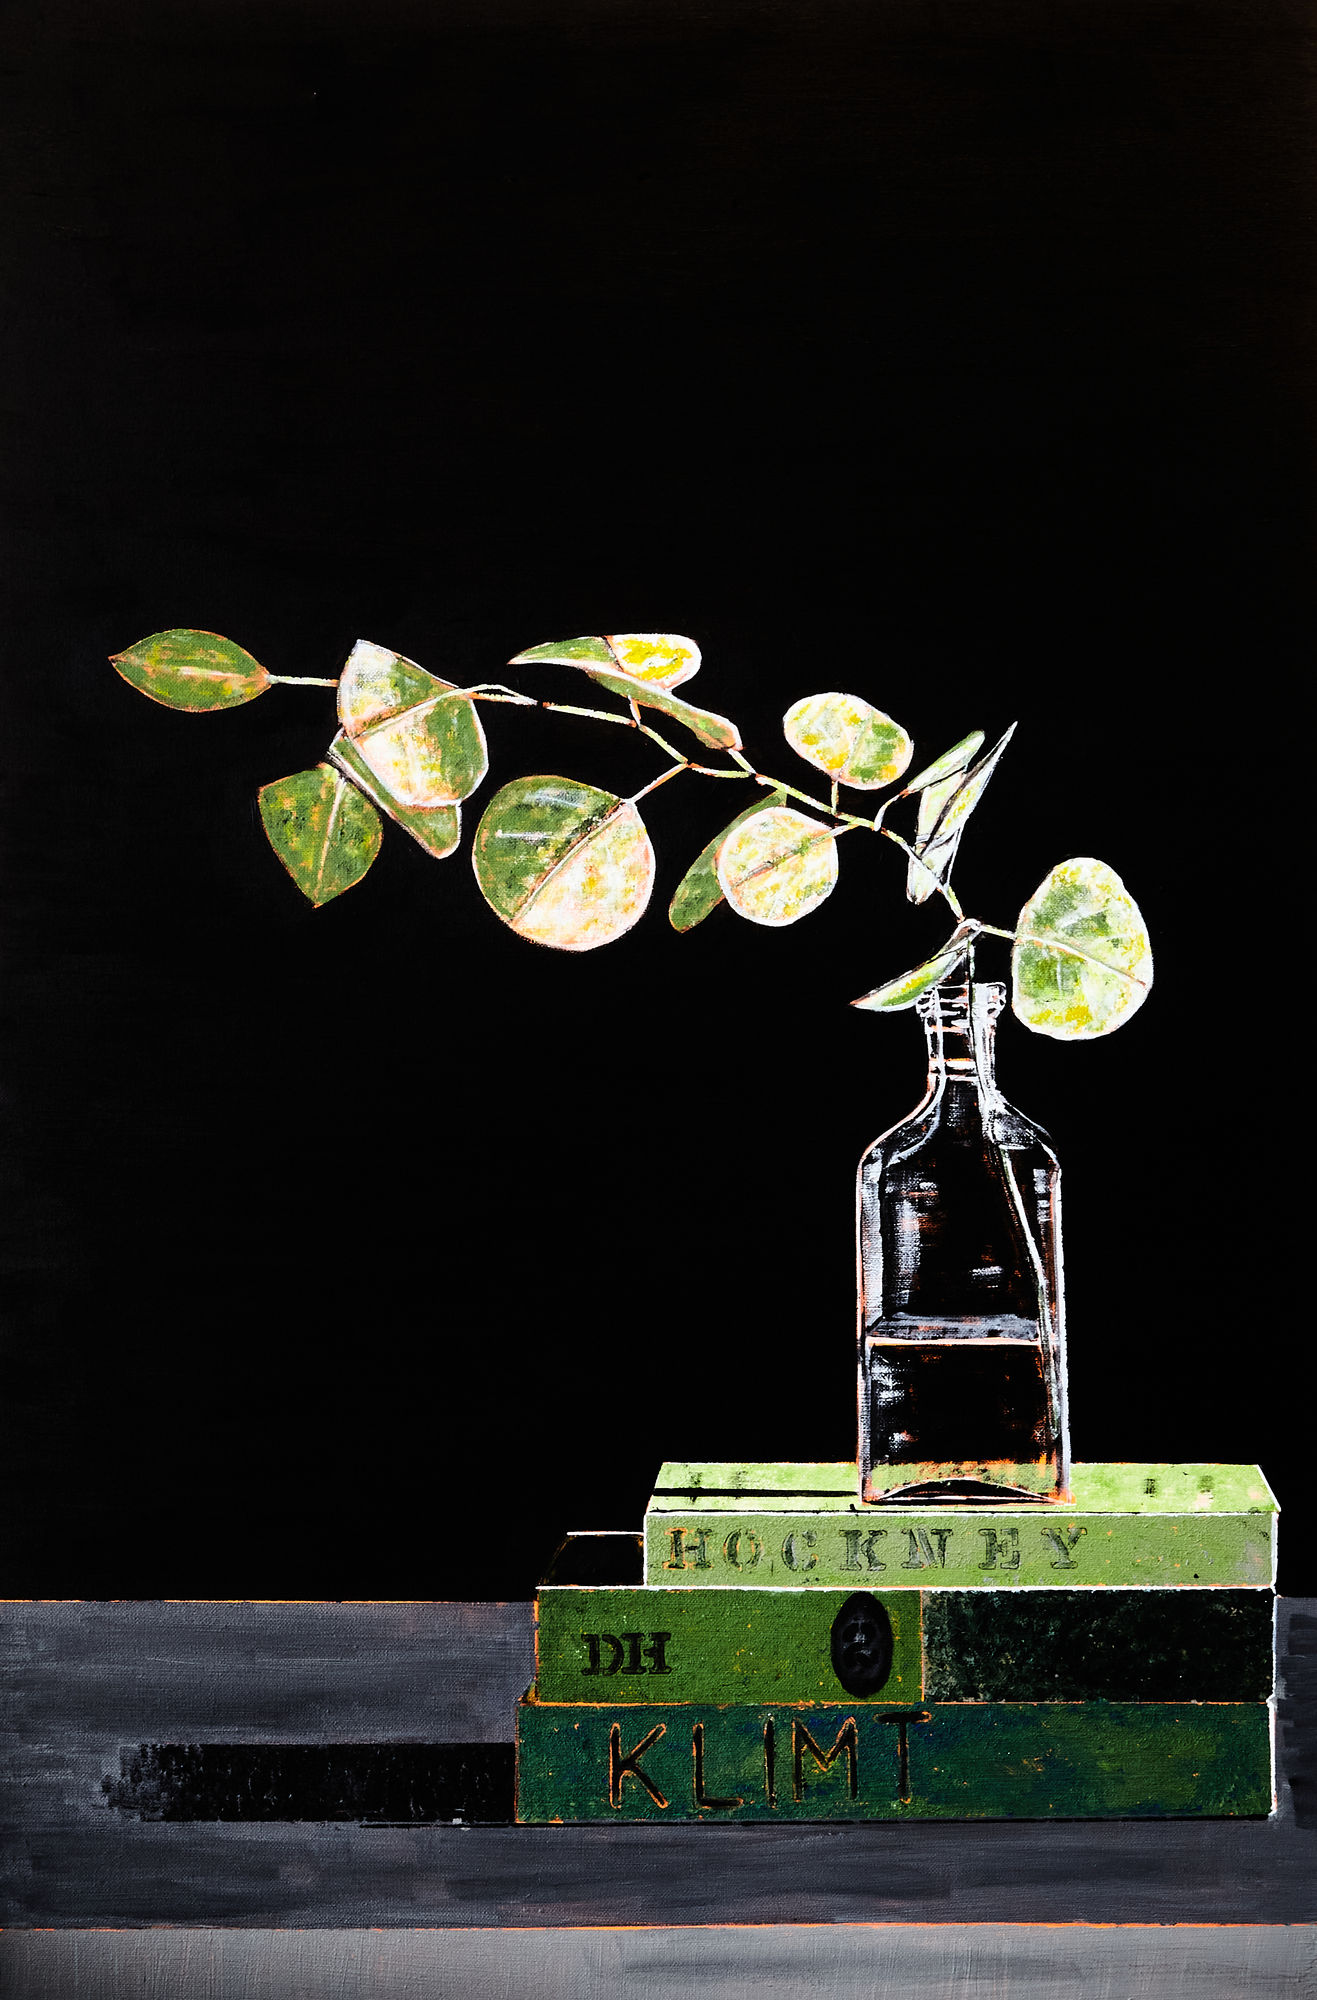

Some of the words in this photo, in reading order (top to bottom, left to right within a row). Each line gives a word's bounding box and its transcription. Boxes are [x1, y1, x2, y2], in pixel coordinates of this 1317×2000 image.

[664, 1525, 1087, 1571] HOCKNEY
[581, 1632, 672, 1676] DH
[609, 1711, 932, 1809] KLIMT
